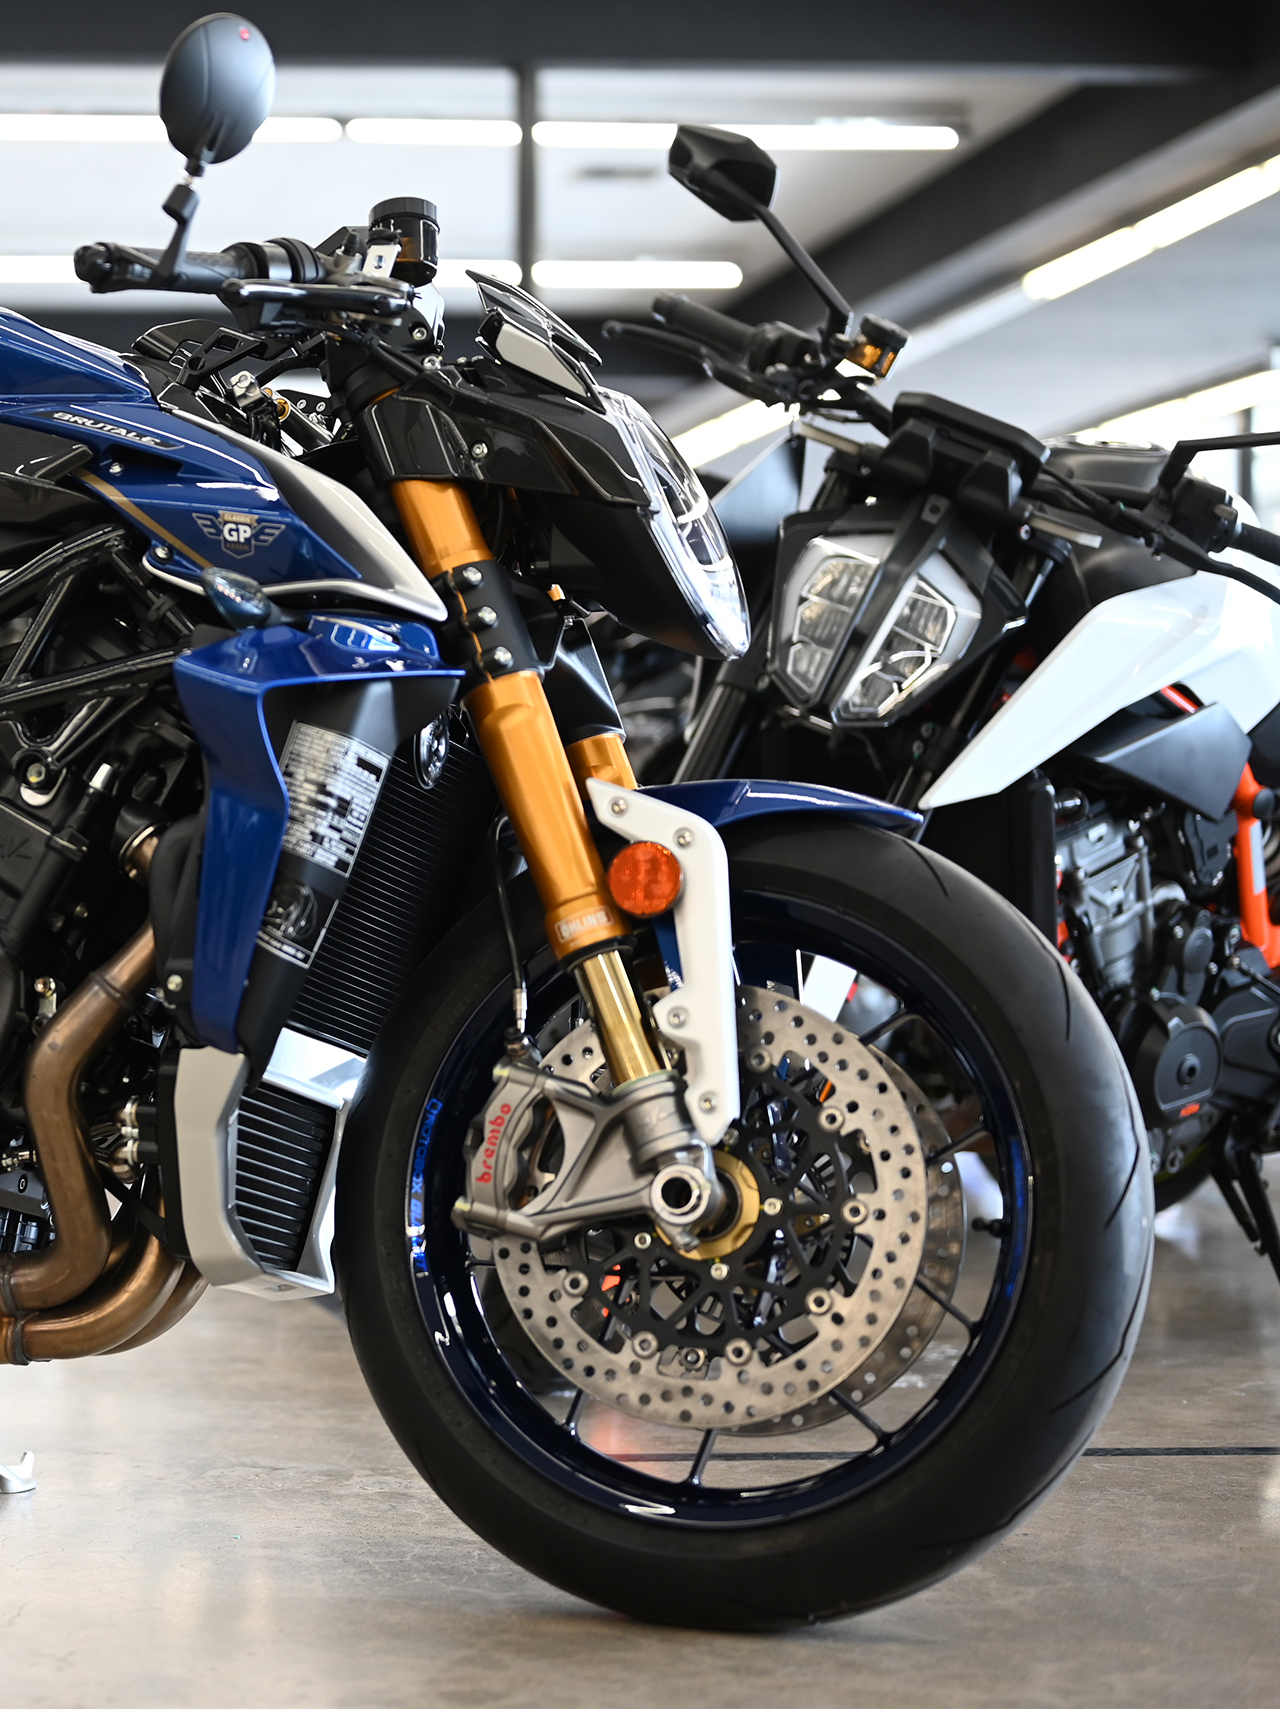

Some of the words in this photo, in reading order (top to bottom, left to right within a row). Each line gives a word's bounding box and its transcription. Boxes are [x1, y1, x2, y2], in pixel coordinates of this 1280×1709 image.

[52, 411, 162, 445] BRUTALE
[223, 523, 252, 543] GP
[411, 1111, 438, 1193] ROTOBOX
[476, 1103, 512, 1183] brembo
